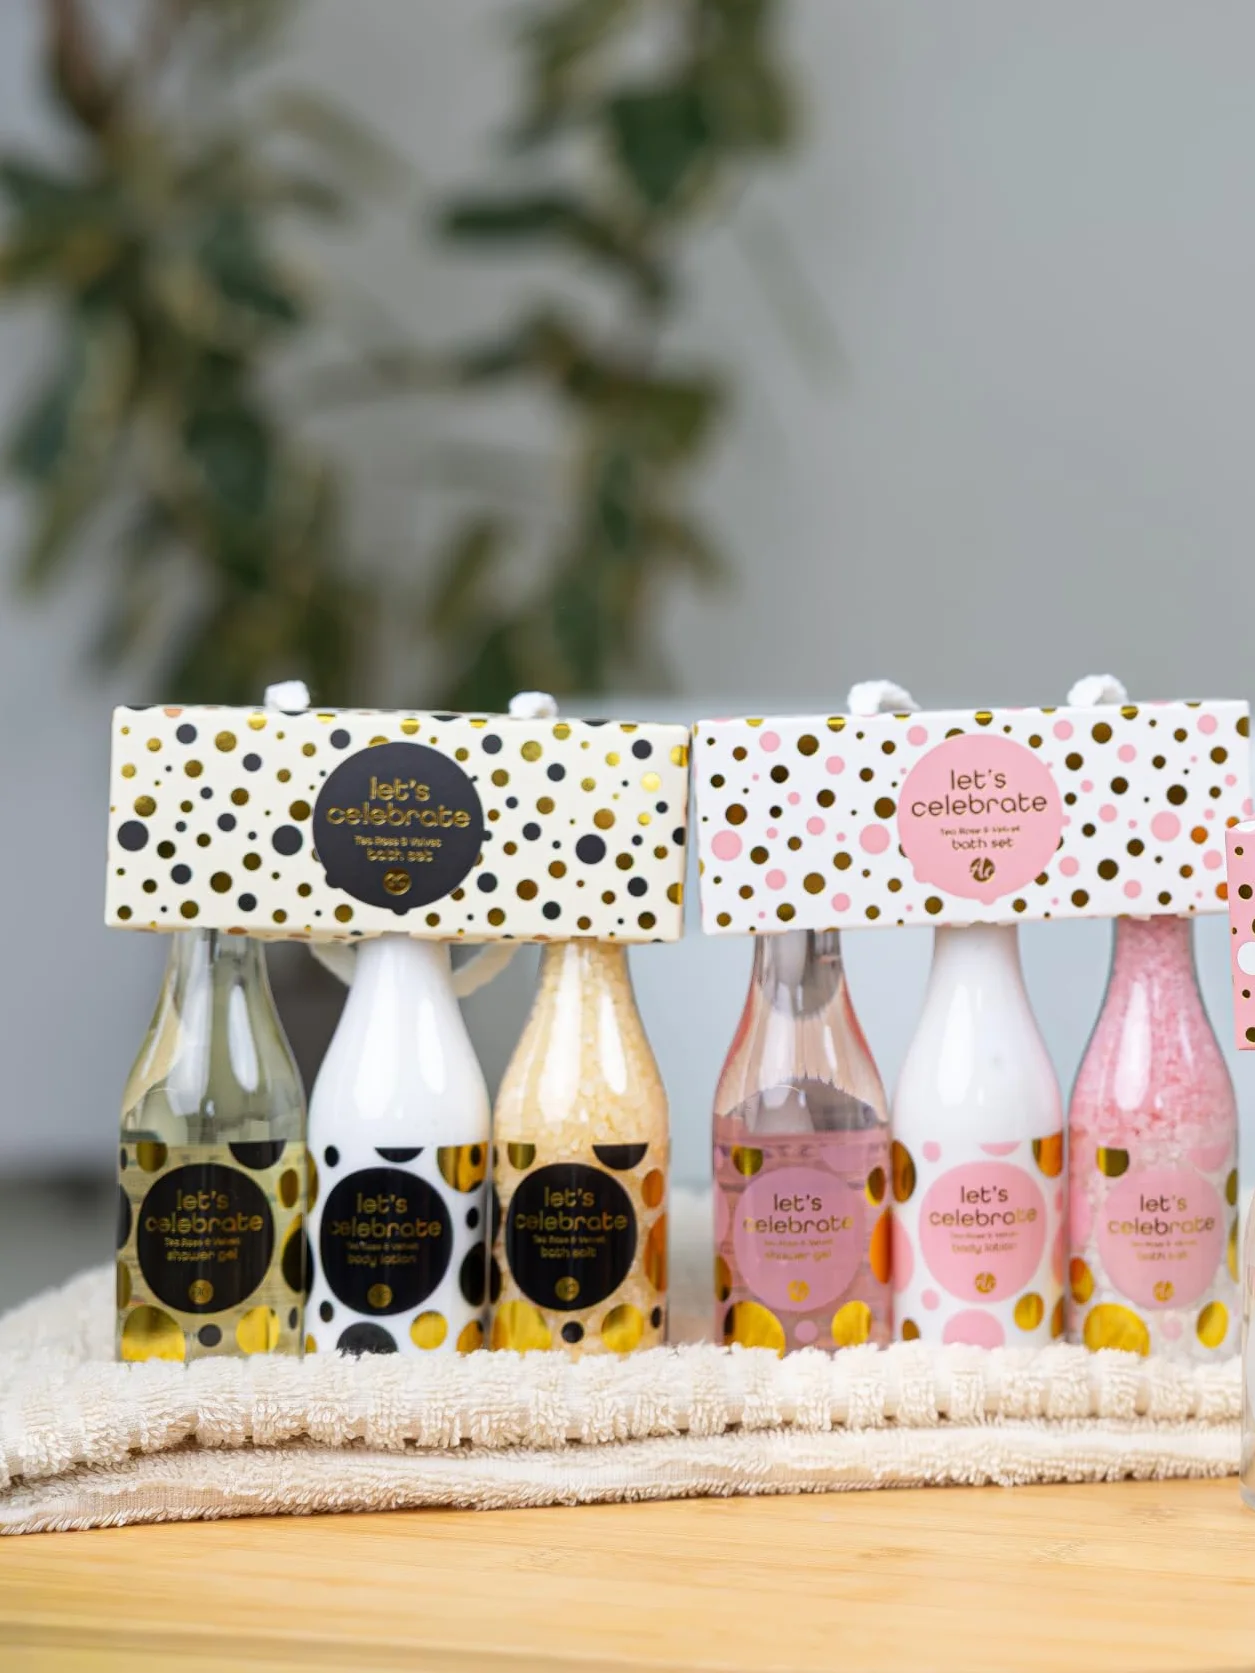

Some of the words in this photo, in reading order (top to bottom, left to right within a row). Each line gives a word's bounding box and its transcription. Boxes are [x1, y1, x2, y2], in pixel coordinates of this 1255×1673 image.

[370, 776, 430, 801] let's
[950, 769, 1007, 790] let's
[326, 802, 471, 828] celebrate
[911, 793, 1048, 817] celebrate
[952, 838, 988, 850] bath
[991, 838, 1014, 847] set
[177, 1189, 229, 1211] let's
[357, 1193, 408, 1214] let's
[544, 1186, 595, 1208] let's
[774, 1193, 823, 1212] let's
[961, 1185, 1009, 1204] let's
[1140, 1194, 1187, 1213] let's
[145, 1212, 264, 1233] celebrate
[328, 1216, 442, 1238] celebrate
[515, 1210, 628, 1231] celebrate
[743, 1215, 854, 1234] celebrate
[929, 1207, 1037, 1227] celebrate
[1108, 1217, 1215, 1236] celebrate
